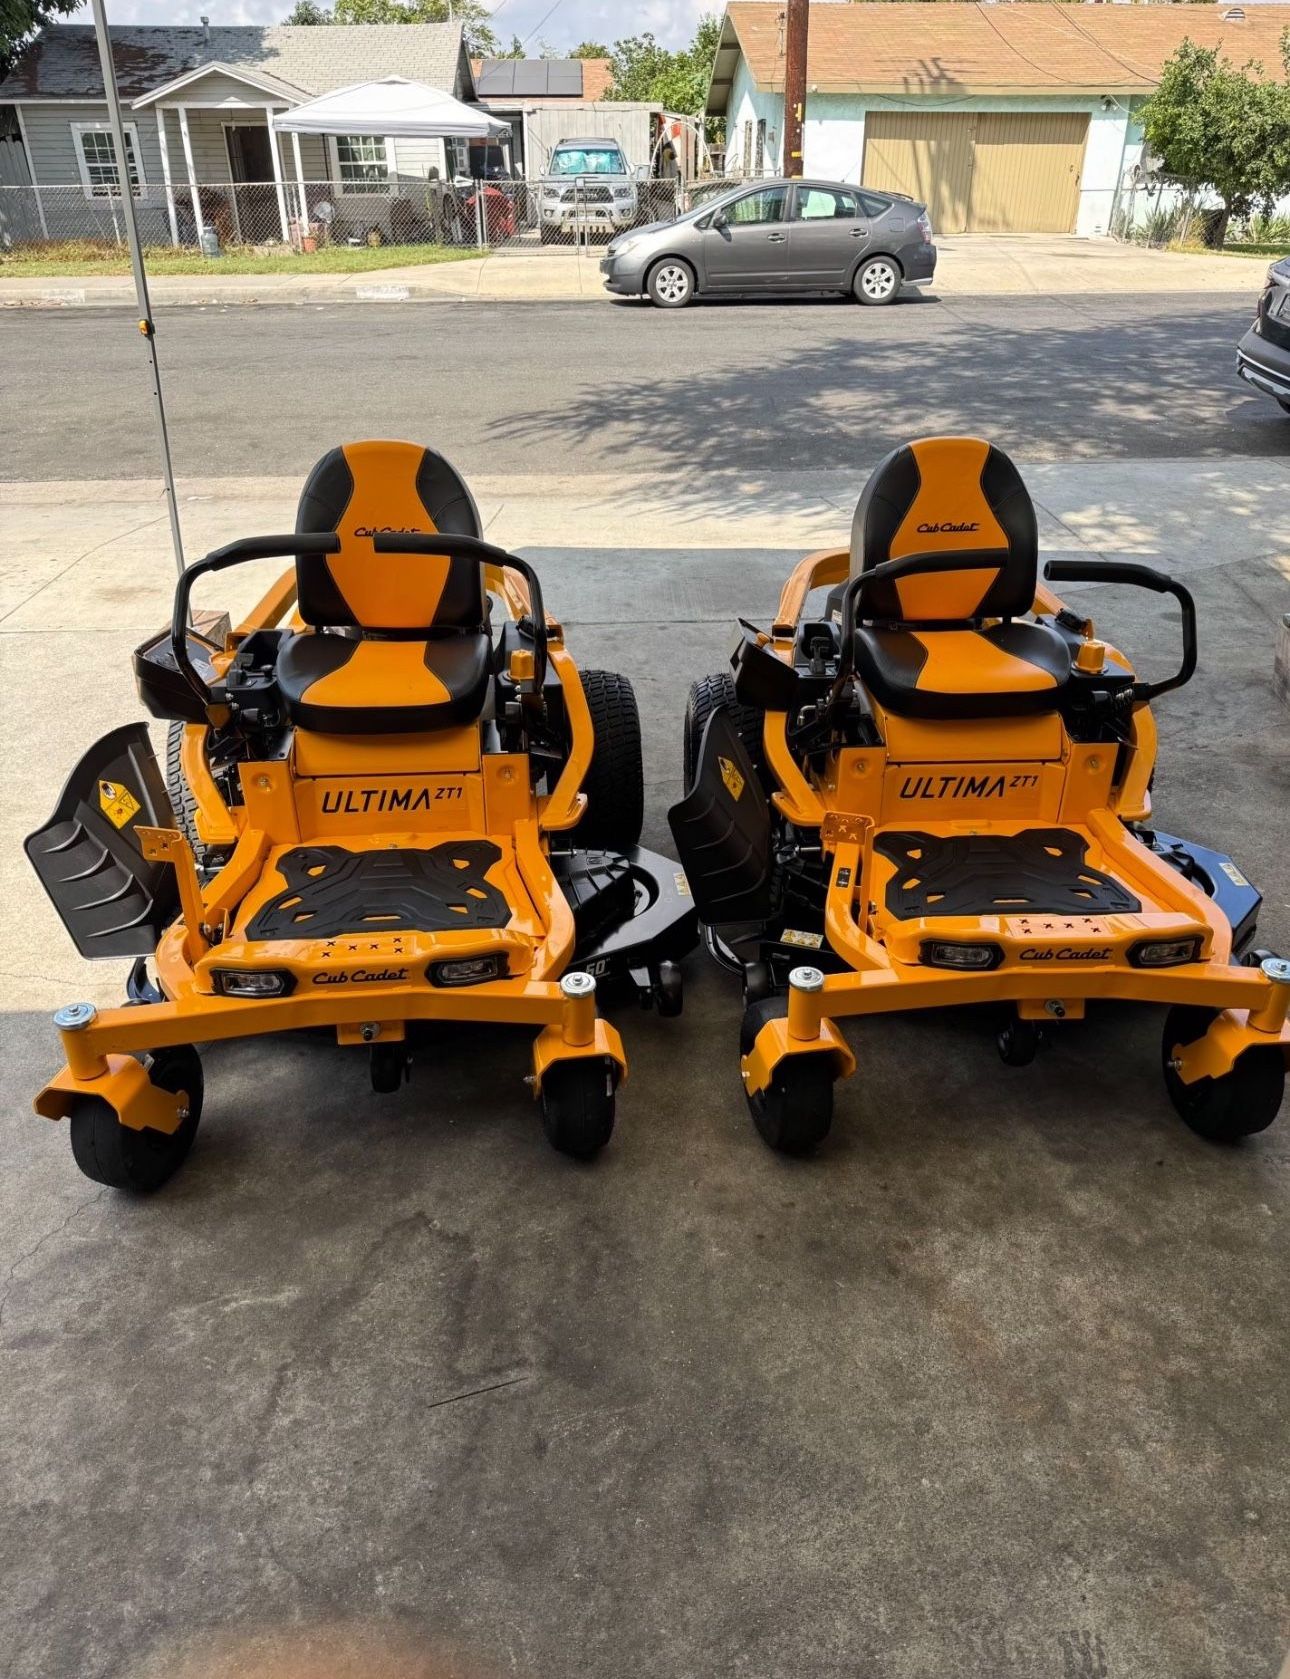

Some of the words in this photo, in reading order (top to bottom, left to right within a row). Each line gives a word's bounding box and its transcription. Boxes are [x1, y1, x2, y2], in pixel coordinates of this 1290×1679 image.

[917, 522, 939, 533] Cub
[941, 522, 980, 532] Cadet
[900, 776, 1005, 799] ULTIMA
[1009, 775, 1039, 787] ZT1
[321, 788, 431, 813] ULTIMA
[434, 787, 463, 799] ZT1
[1019, 948, 1053, 960] Cub
[1056, 947, 1113, 960] Cadet
[312, 971, 349, 985] Cub
[351, 967, 409, 982] Cadet
